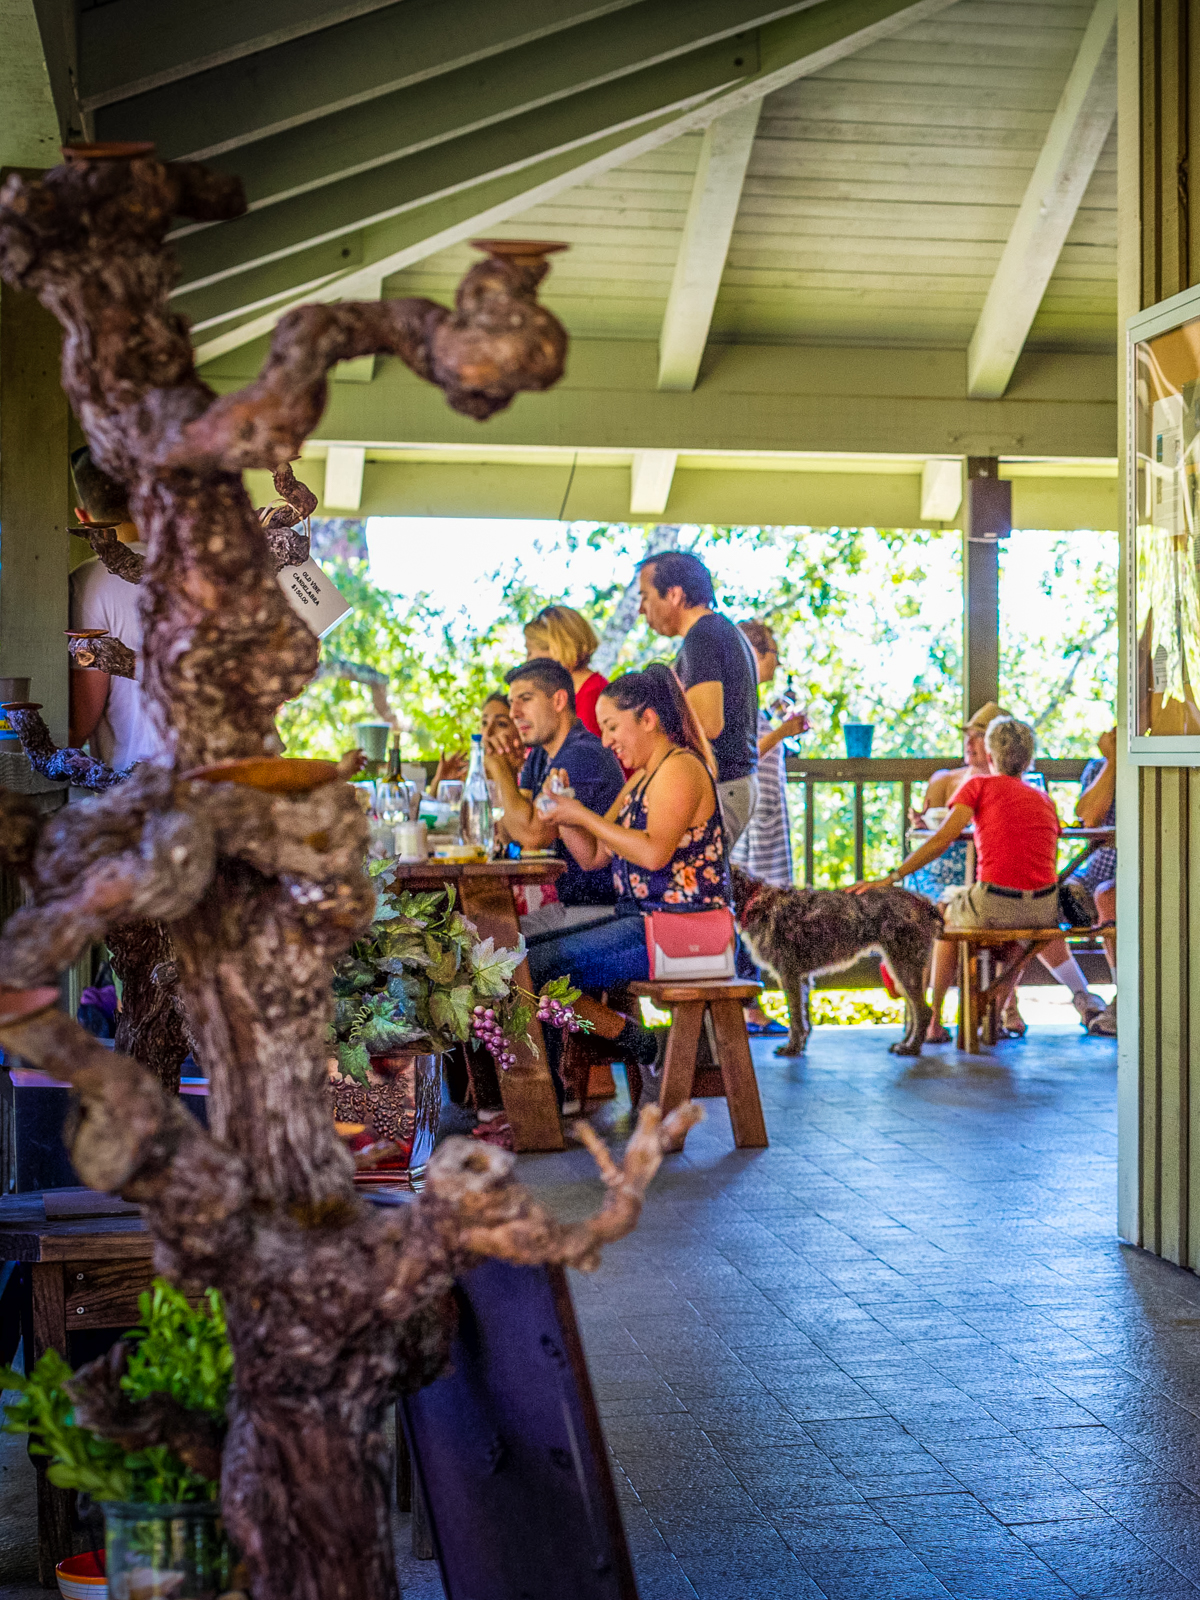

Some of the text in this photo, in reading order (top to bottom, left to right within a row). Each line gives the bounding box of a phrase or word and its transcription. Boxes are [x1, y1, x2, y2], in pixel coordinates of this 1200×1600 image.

[292, 572, 320, 606] CANDELABRA
[302, 571, 321, 594] OLD VINE
[291, 584, 309, 605] $150.00
